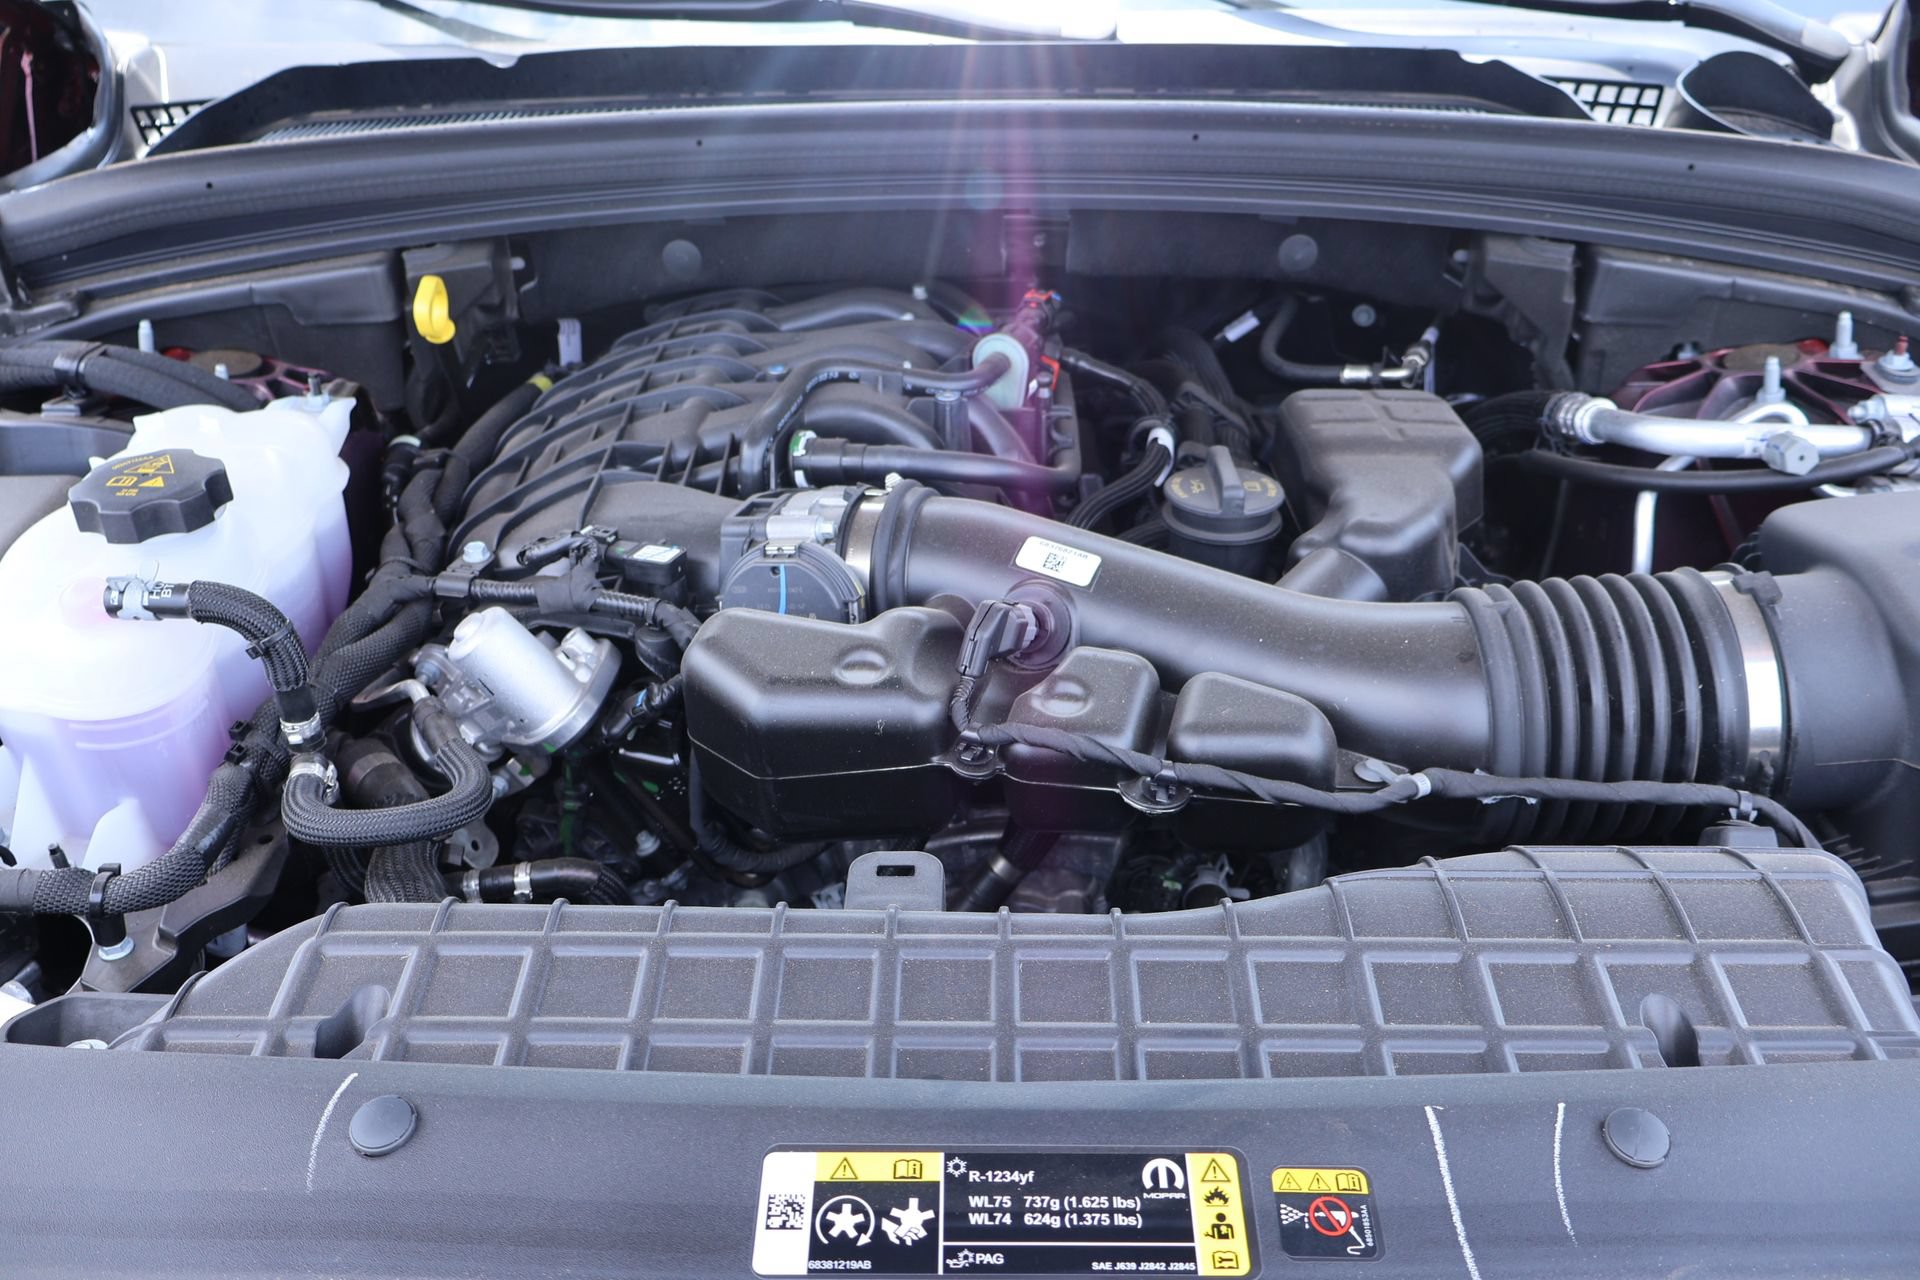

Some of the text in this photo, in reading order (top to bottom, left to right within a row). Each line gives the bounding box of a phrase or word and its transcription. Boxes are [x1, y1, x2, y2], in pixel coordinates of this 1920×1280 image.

[969, 1171, 1035, 1186] R-1234yf
[969, 1196, 1141, 1211] WL75 737g (1.625 lbs)
[969, 1213, 1143, 1228] WL74 624g (1.375 lbs)
[808, 1260, 872, 1270] 68381219AB
[976, 1253, 1004, 1265] PAG
[1092, 1262, 1196, 1270] SAE J639 J2842 J2845
